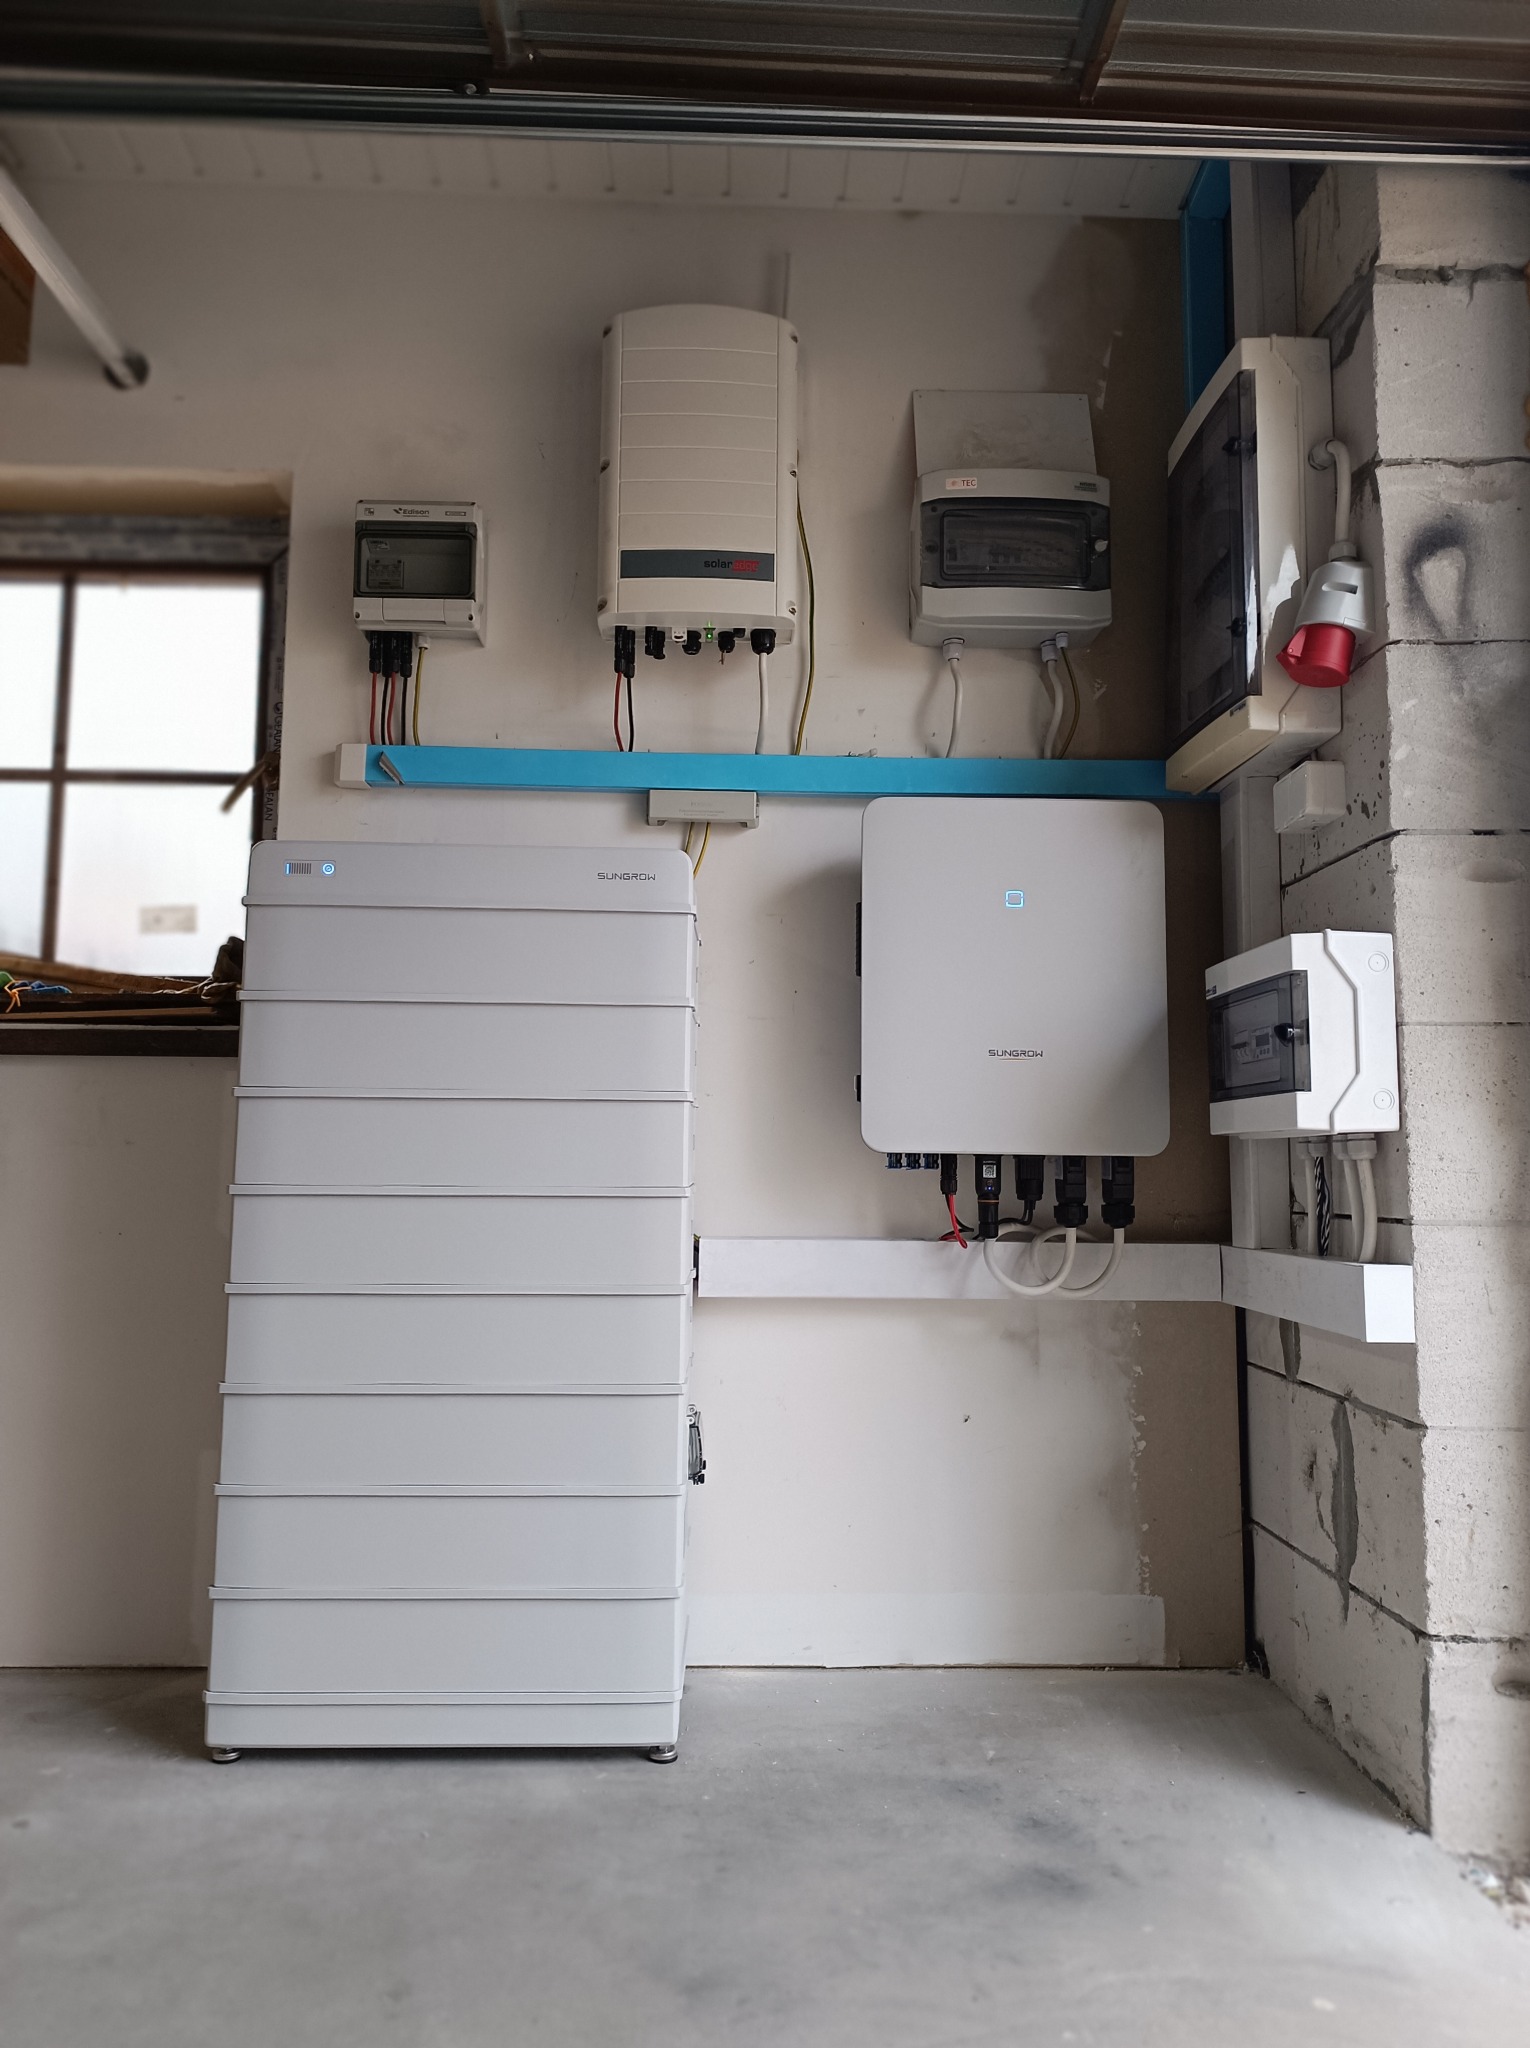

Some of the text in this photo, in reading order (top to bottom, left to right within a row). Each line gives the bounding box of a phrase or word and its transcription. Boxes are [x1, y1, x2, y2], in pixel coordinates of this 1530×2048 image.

[961, 479, 976, 487] TEC
[597, 872, 656, 881] SUNGROW
[988, 1049, 1043, 1058] SUNGROW
